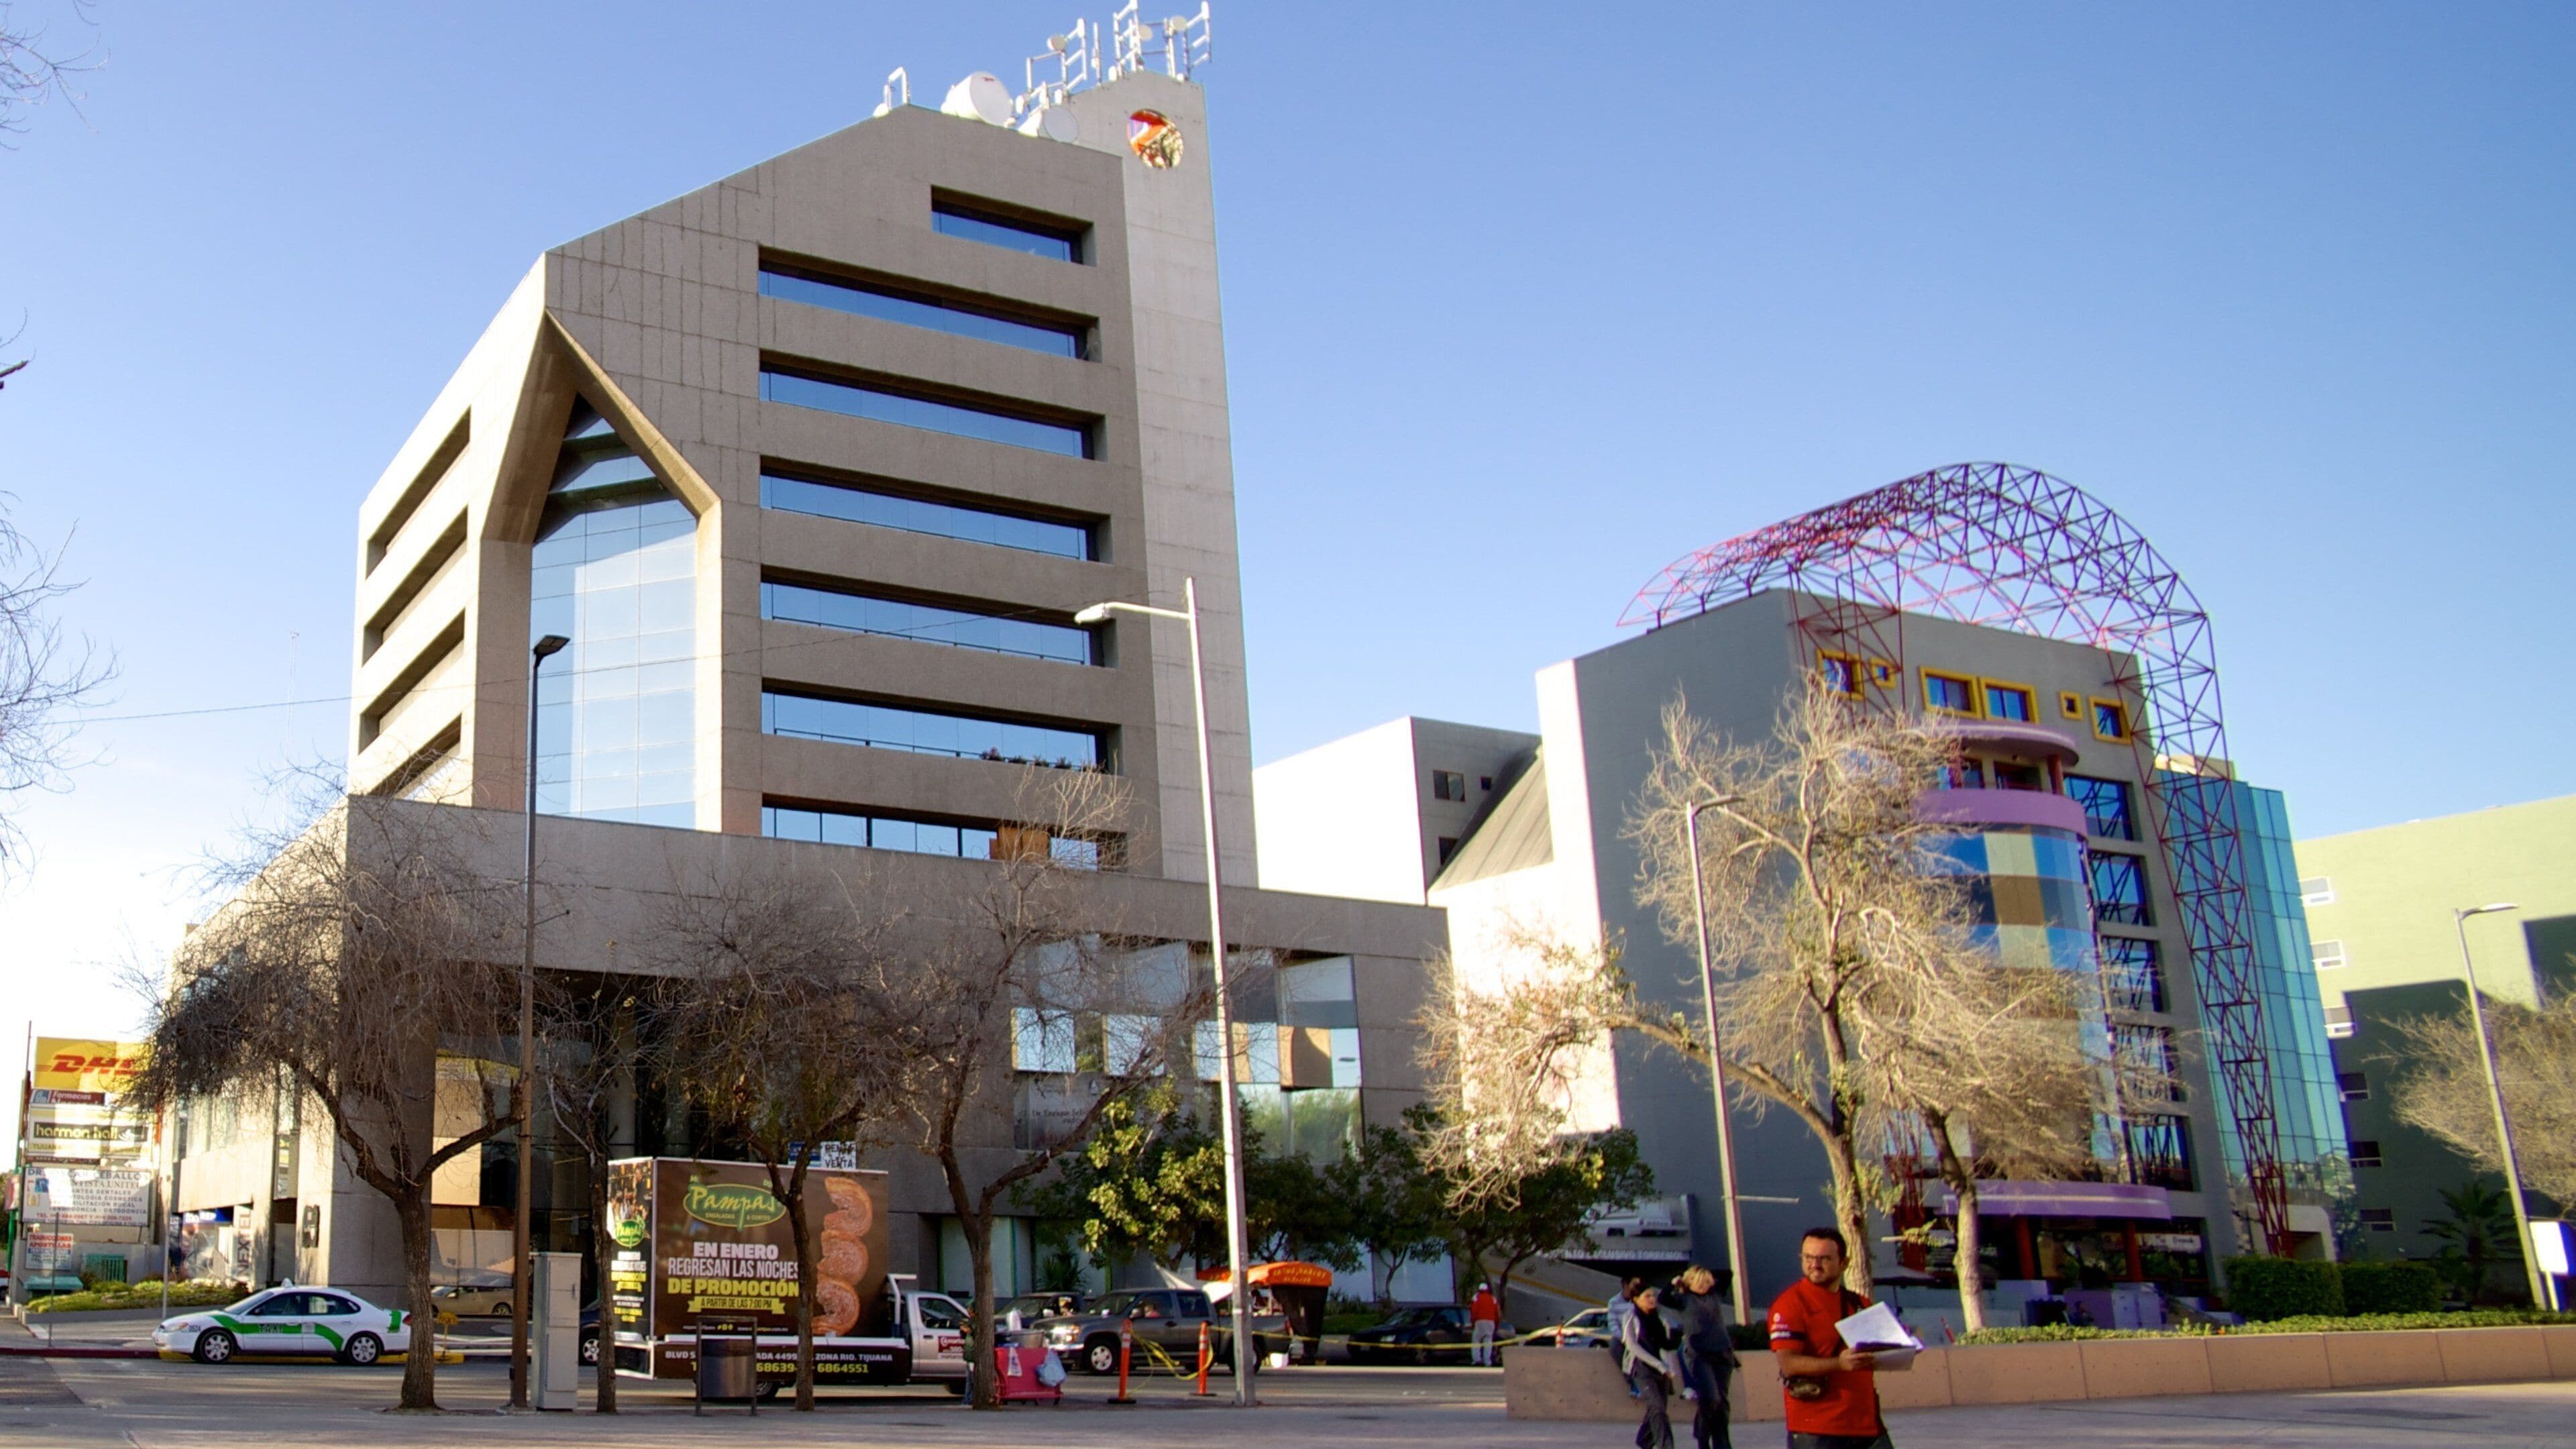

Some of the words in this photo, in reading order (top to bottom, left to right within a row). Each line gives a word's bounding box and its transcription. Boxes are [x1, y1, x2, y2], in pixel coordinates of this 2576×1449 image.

[51, 1055, 141, 1076] DHL
[53, 1090, 91, 1100] Farmacias
[36, 1124, 91, 1138] harmon
[94, 1126, 119, 1140] hall
[691, 1186, 775, 1230] Pampas
[693, 1242, 718, 1258] EN
[720, 1243, 779, 1260] ENERO
[668, 1256, 731, 1276] REGRESAN
[733, 1260, 755, 1278] LAS
[756, 1260, 799, 1279] NOCHES
[667, 1277, 692, 1294] DE
[694, 1278, 799, 1297] PROMOCIÓN
[706, 1298, 727, 1307] PARTIR
[729, 1298, 736, 1307] DE
[737, 1299, 748, 1307] LAS
[763, 1299, 772, 1308] PM
[258, 1324, 282, 1333] TAXI
[665, 1351, 690, 1359] BLVD
[815, 1353, 838, 1361] ZONA
[859, 1354, 893, 1363] TIJUANA
[816, 1363, 869, 1373] 6864551
